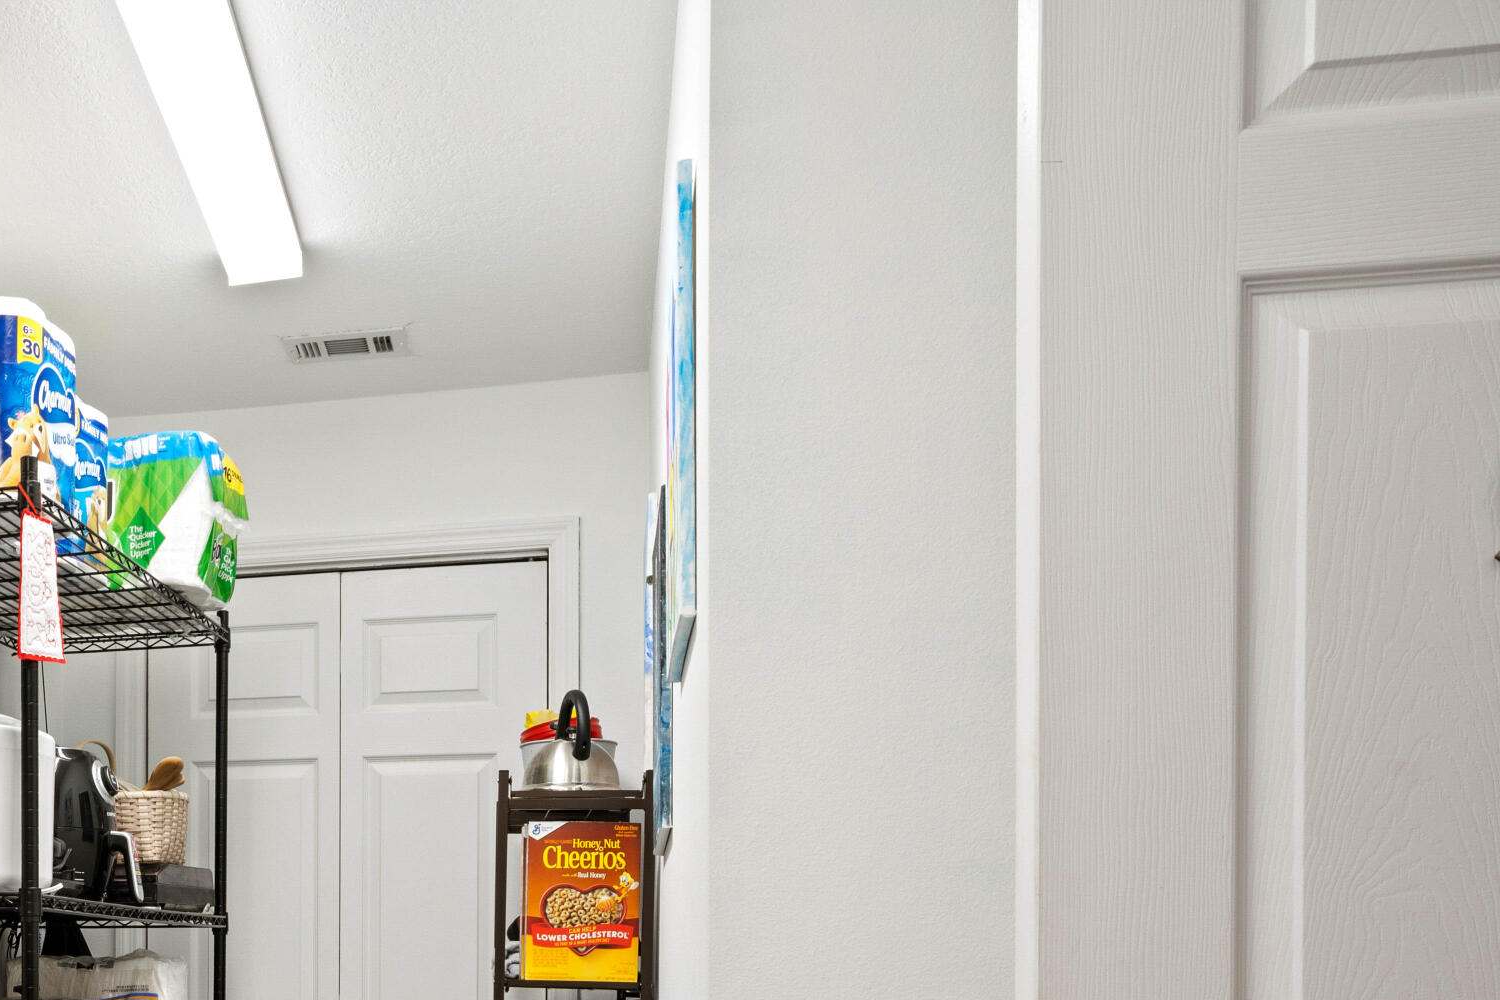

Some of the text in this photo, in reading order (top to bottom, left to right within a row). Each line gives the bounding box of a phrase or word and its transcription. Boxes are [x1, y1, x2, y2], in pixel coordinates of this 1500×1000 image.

[22, 338, 41, 359] 30
[38, 379, 73, 419] Charmin
[52, 432, 67, 445] Ultra
[224, 466, 232, 483] 16
[129, 525, 143, 533] The
[128, 531, 157, 542] Quicker
[130, 539, 152, 550] Picker
[130, 547, 153, 559] Upper
[572, 838, 602, 851] Honey
[603, 838, 621, 849] Nut
[542, 845, 626, 870] Cheerios
[589, 871, 606, 880] Honey
[536, 930, 629, 942] LOWER CHOLESTEROL
